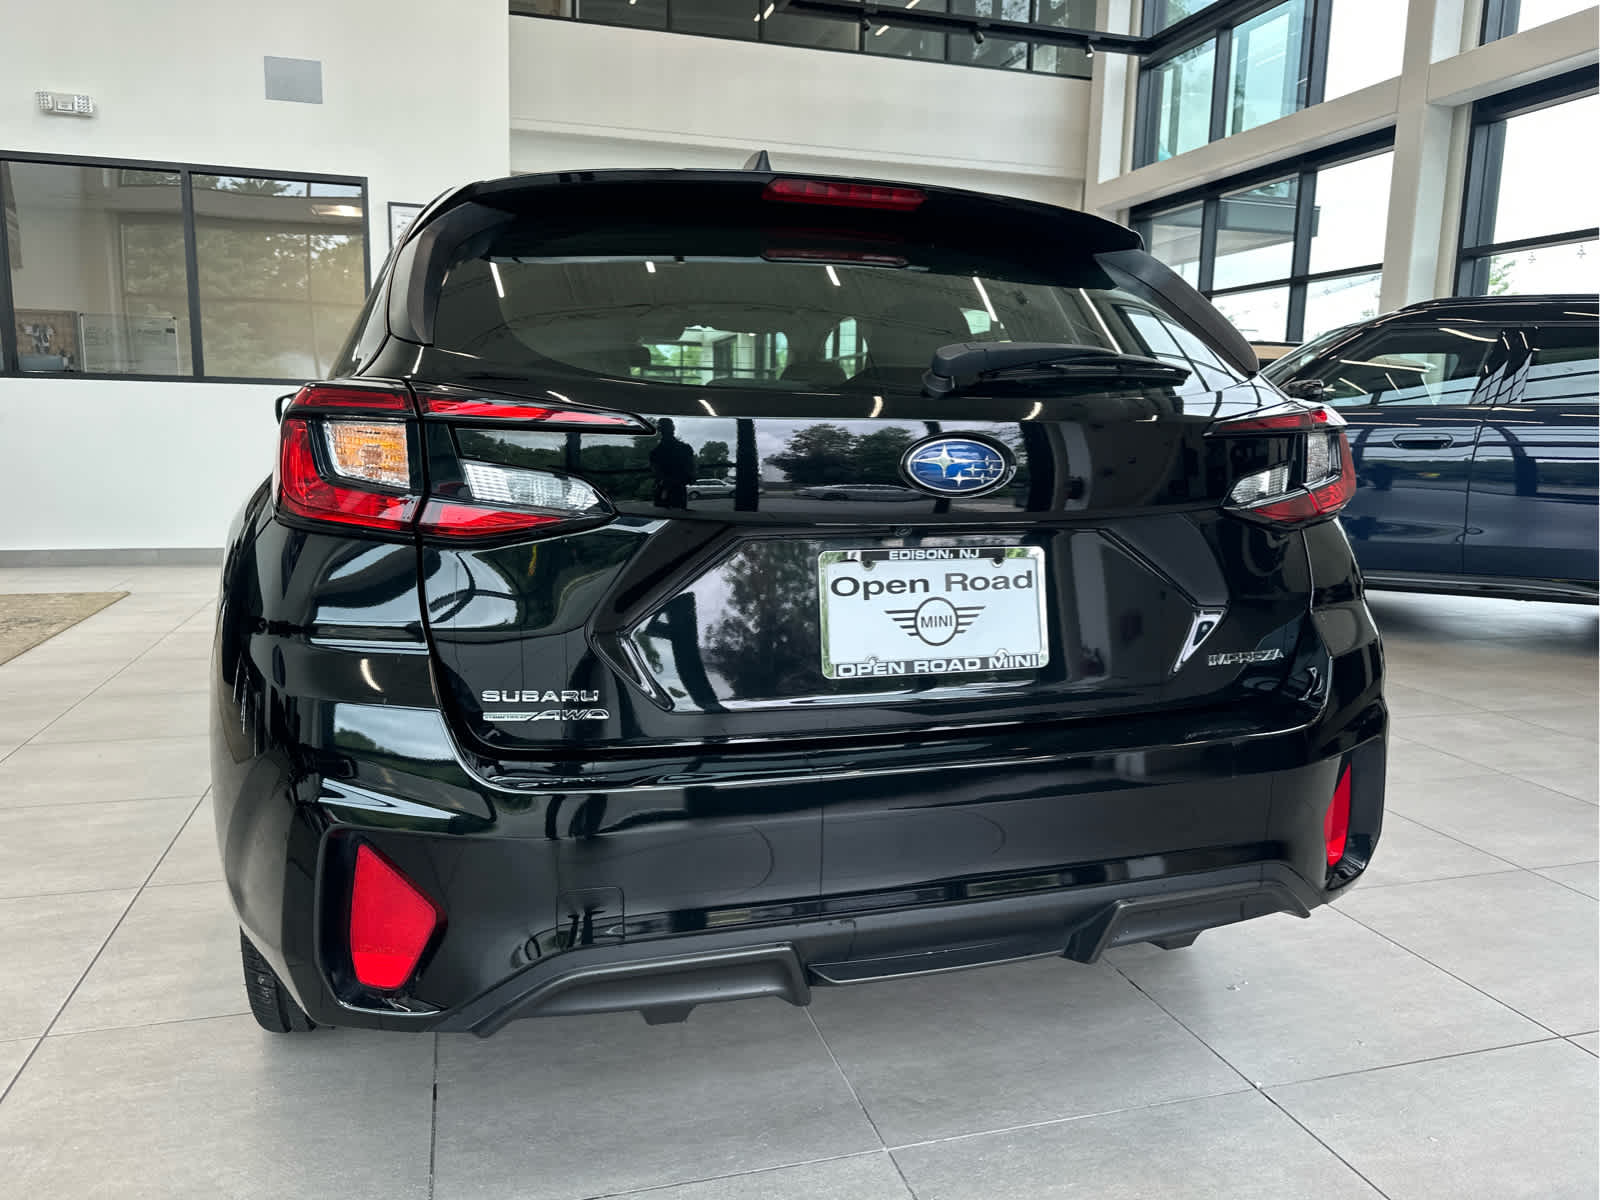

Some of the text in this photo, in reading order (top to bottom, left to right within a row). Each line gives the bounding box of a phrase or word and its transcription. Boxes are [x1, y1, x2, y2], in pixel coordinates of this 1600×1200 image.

[889, 549, 980, 561] EDISON, NJ
[830, 570, 1033, 601] Open Road
[920, 615, 953, 629] MINI
[838, 654, 1040, 677] OPEN ROAD MINI
[481, 689, 600, 703] SUBARU
[530, 708, 610, 721] AWD
